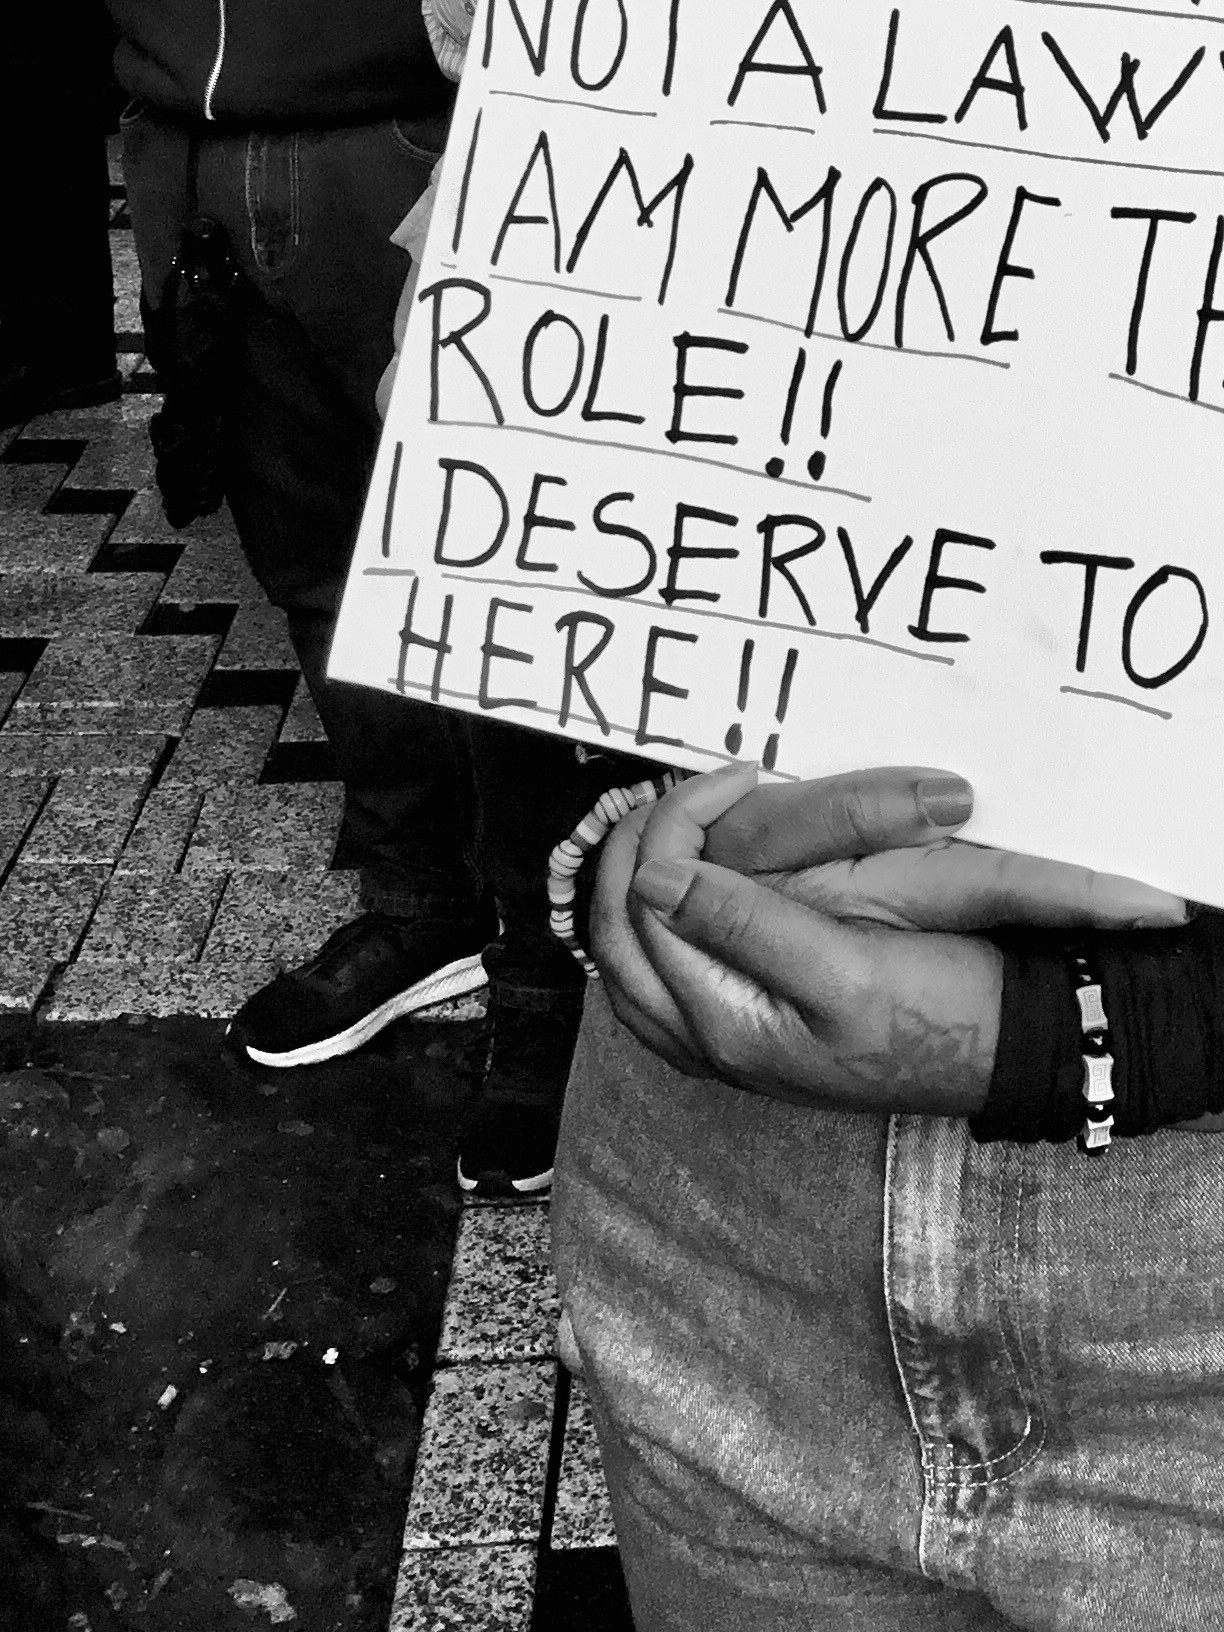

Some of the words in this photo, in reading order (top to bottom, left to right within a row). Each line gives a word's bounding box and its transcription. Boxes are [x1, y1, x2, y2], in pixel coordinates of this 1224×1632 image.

[451, 107, 484, 255] I
[489, 130, 695, 306] AM
[725, 165, 1062, 347] MORE
[418, 277, 844, 481] ROLE!!
[381, 441, 403, 559] I
[434, 457, 996, 643] DESERVE
[1040, 550, 1210, 690] TO
[398, 576, 800, 771] HERE!!
